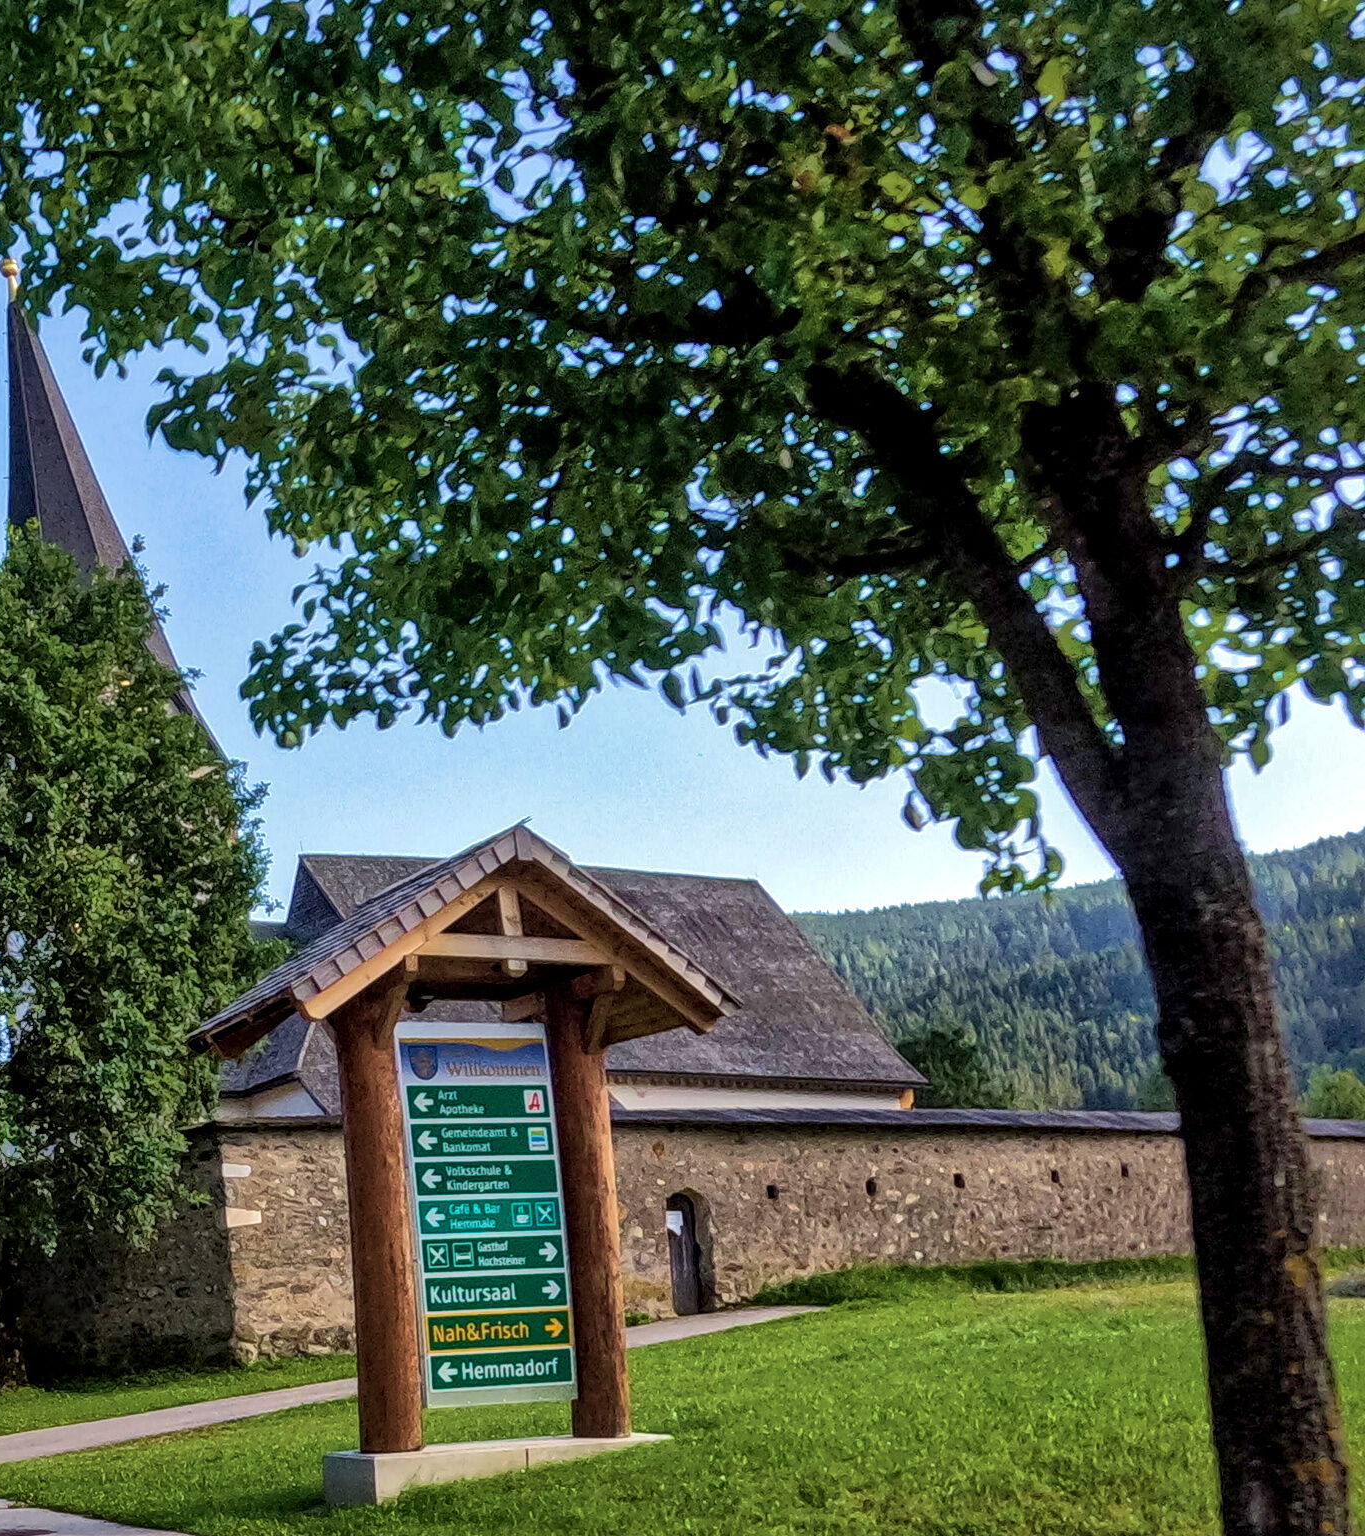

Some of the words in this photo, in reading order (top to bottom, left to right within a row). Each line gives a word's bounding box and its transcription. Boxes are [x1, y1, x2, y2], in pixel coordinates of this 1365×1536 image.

[445, 1062, 541, 1077] Willkommen
[438, 1090, 458, 1101] Arzt
[440, 1105, 484, 1115] Apotheke
[441, 1127, 507, 1138] Gemeindeamt
[510, 1127, 518, 1137] &
[443, 1143, 491, 1153] Bankomat
[446, 1165, 501, 1176] Volksschule
[504, 1165, 513, 1175] &
[447, 1180, 509, 1192] Kindergarten
[473, 1203, 481, 1214] &
[484, 1203, 500, 1214] Bar
[477, 1240, 508, 1252] Gasthof
[430, 1282, 517, 1304] Kultursaal
[433, 1321, 529, 1342] Nah&Frisch
[462, 1358, 559, 1380] Hemmadorf
